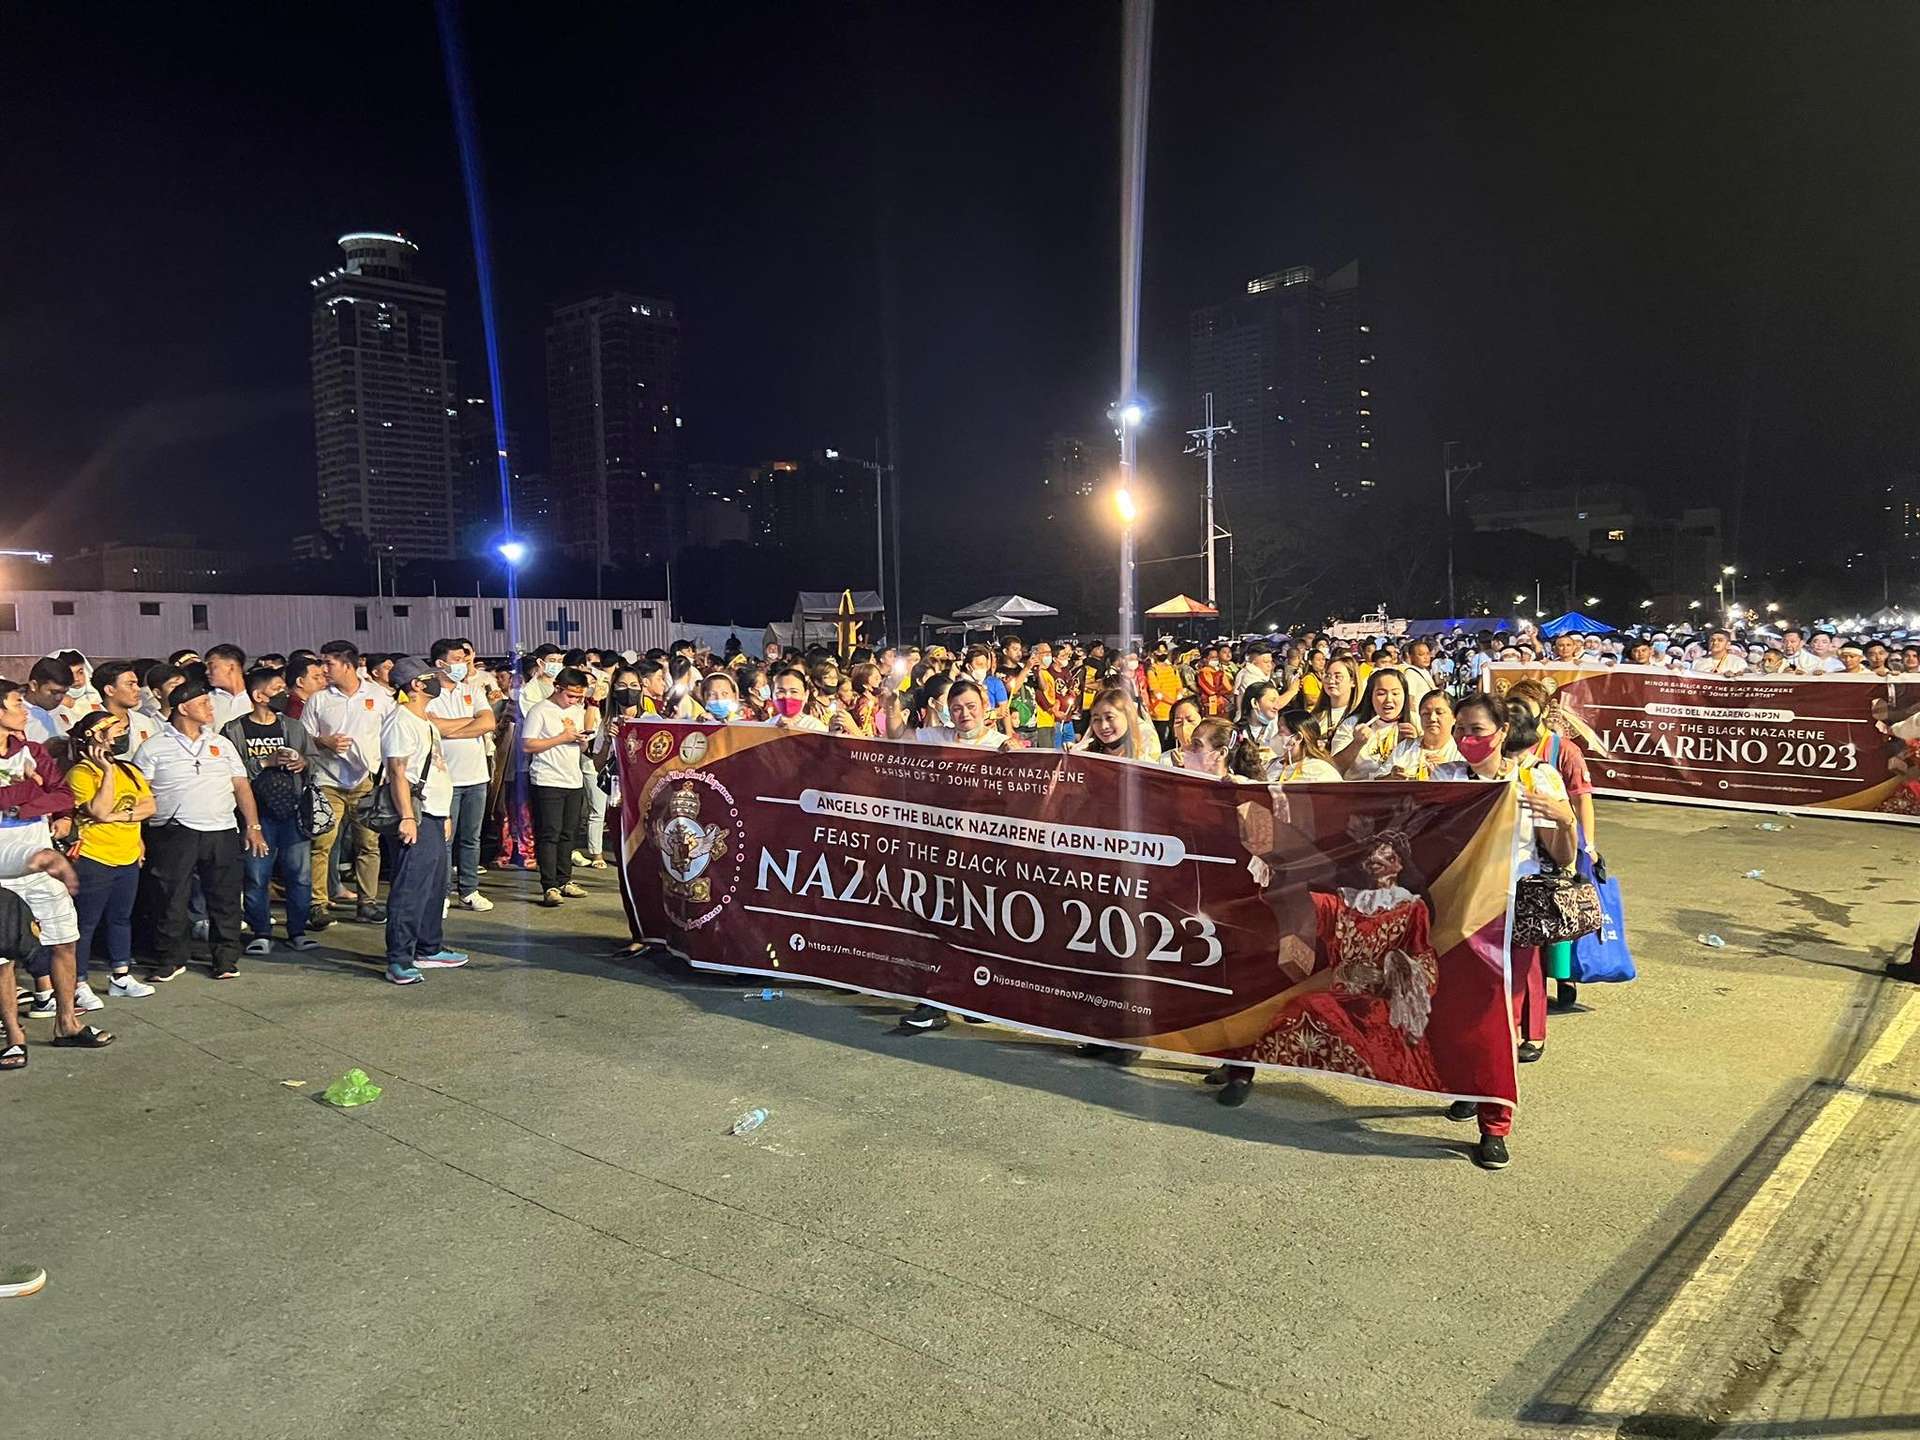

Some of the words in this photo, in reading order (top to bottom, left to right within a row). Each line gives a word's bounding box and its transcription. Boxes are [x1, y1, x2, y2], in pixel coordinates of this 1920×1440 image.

[1616, 718, 1653, 730] FEAST
[1658, 721, 1676, 731] OF
[1680, 723, 1703, 734] THE
[1707, 725, 1746, 737] BLACK
[1750, 727, 1825, 741] NAZARENE
[1655, 706, 1683, 715] HIJOS
[1685, 708, 1701, 716] DEL
[1703, 710, 1781, 719] NAZARENO-NPJN
[850, 750, 884, 764] MINOR
[886, 754, 935, 770] BASILICA
[938, 761, 953, 771] OF
[956, 762, 977, 775] THE
[980, 764, 1014, 778] BLACK
[1018, 768, 1085, 784] NAZARENE
[1587, 729, 1768, 765] NAZARENO
[1776, 741, 1858, 772] 2023
[874, 766, 912, 779] PARISH
[913, 769, 926, 780] OF
[948, 774, 979, 788] JOHN
[983, 779, 1003, 791] THE
[816, 796, 869, 816] ANGELS
[871, 804, 891, 818] OF
[893, 807, 919, 823] THE
[921, 811, 964, 832] BLACK
[968, 818, 1046, 845] NAZARENE
[1051, 831, 1164, 861] (ABN-NPJN)
[813, 827, 871, 850] FEAST
[876, 837, 901, 855] OF
[907, 841, 938, 864] THE
[946, 849, 1007, 878] BLACK
[1016, 862, 1150, 900] NAZARENE
[754, 845, 1046, 944] NAZARENO
[1062, 899, 1223, 968] 2023
